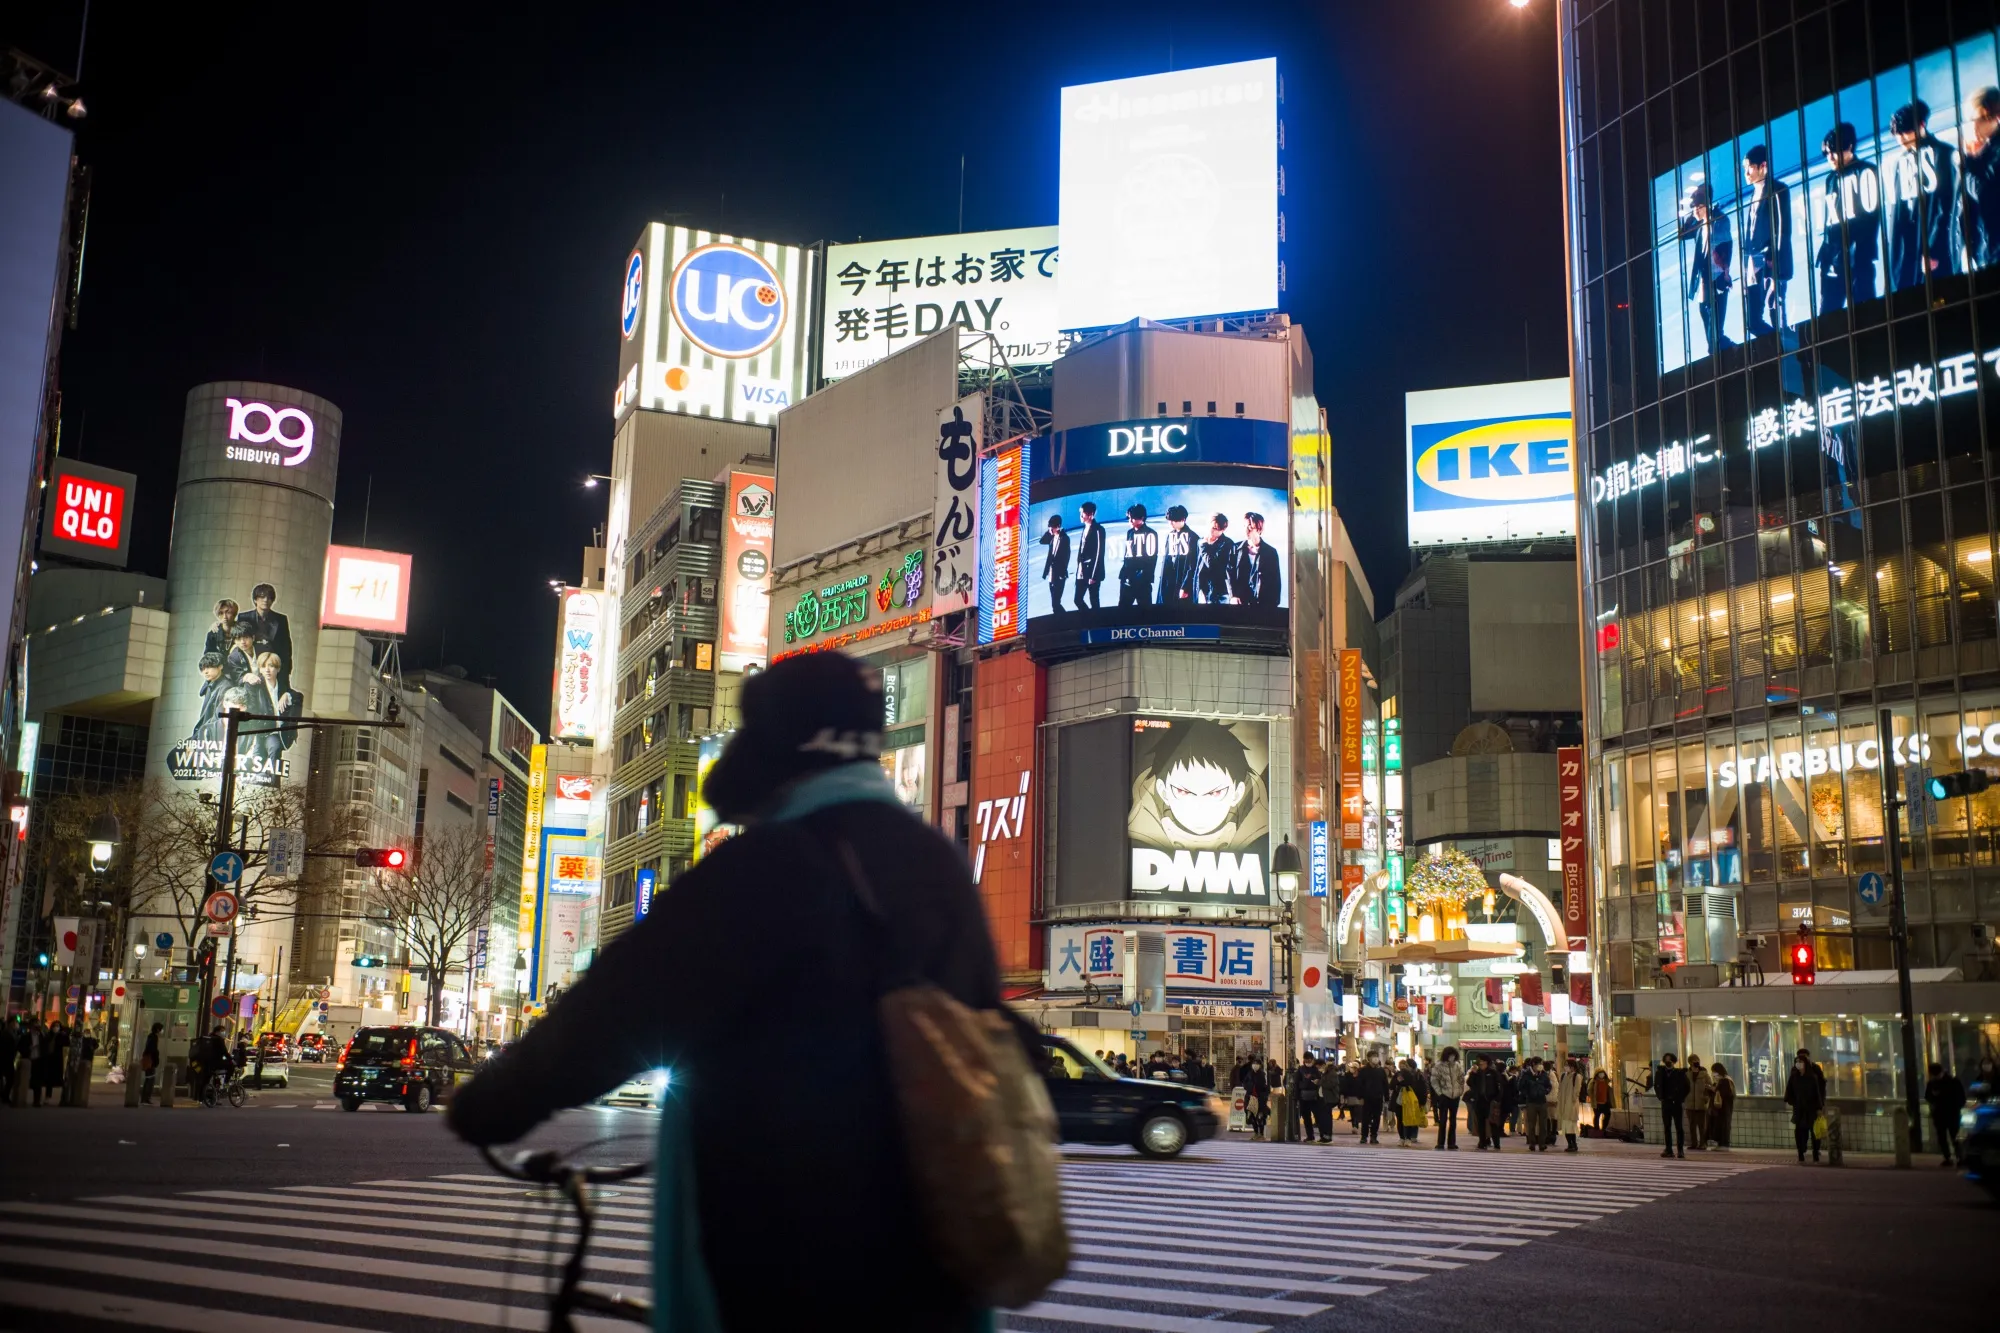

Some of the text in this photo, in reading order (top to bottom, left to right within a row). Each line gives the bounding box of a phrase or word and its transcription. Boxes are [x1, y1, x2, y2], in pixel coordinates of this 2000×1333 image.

[834, 297, 1010, 343] 発毛DAY。
[740, 383, 790, 407] VISA
[225, 397, 315, 467] 109
[1107, 424, 1188, 457] DHC
[226, 446, 280, 466] SHIBUYA
[1437, 438, 1569, 482] IKE
[65, 482, 113, 515] UNI
[933, 405, 977, 606] もんじゃ
[62, 508, 114, 540] QLO
[991, 456, 1014, 629] 三千里薬品
[1107, 531, 1190, 558] SixTOES
[820, 588, 868, 632] 西村
[1110, 626, 1186, 641] DHC Channel
[885, 695, 896, 726] CAM
[176, 739, 224, 751] SHIBUYA1
[1343, 655, 1361, 840] クスリのことなら 三千里
[1719, 733, 1932, 788] STARBUCKS
[175, 751, 291, 778] WINTR SALE
[489, 789, 498, 814] LABI
[1561, 760, 1583, 852] カラオケ
[559, 856, 585, 879] 薬
[1131, 847, 1267, 896] DMM
[641, 878, 652, 914] MIZUHO
[1566, 863, 1580, 921] BIG ECHO
[1058, 935, 1255, 976] 大盛書店
